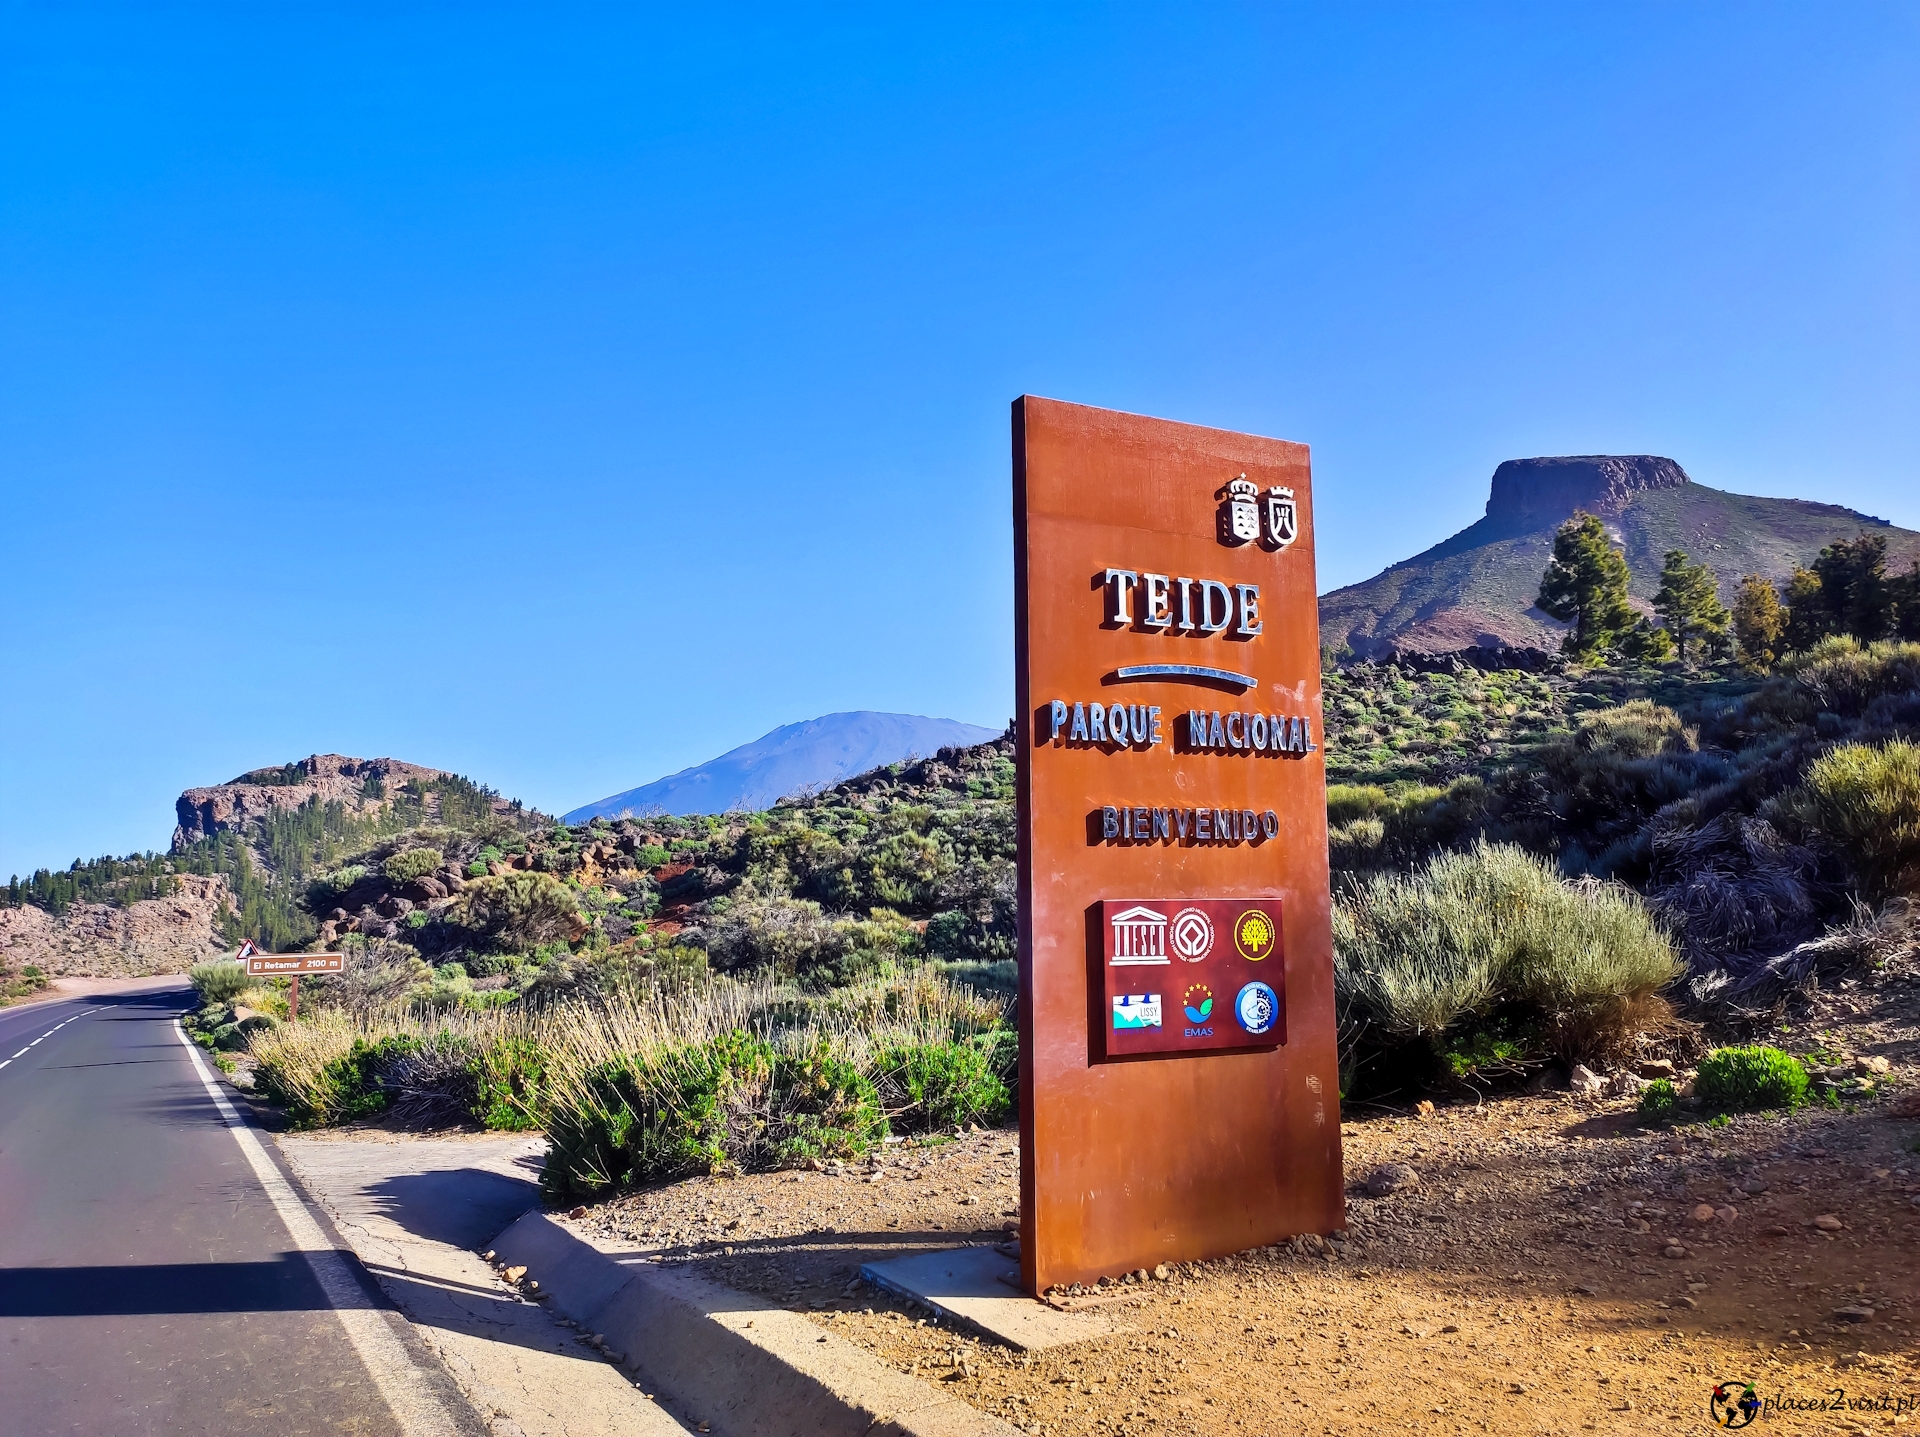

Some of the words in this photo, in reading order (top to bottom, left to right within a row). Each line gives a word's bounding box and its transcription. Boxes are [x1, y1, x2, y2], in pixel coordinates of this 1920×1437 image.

[1105, 567, 1263, 636] TEIDE
[1050, 699, 1162, 747] PARQUE
[1188, 709, 1318, 752] NACIONAL
[1103, 805, 1279, 840] BIENVENIDO
[1114, 925, 1165, 957] UNESCO
[253, 961, 262, 970] El
[264, 960, 301, 970] Retamar
[306, 959, 327, 968] 2100
[1184, 1027, 1214, 1037] EMAS
